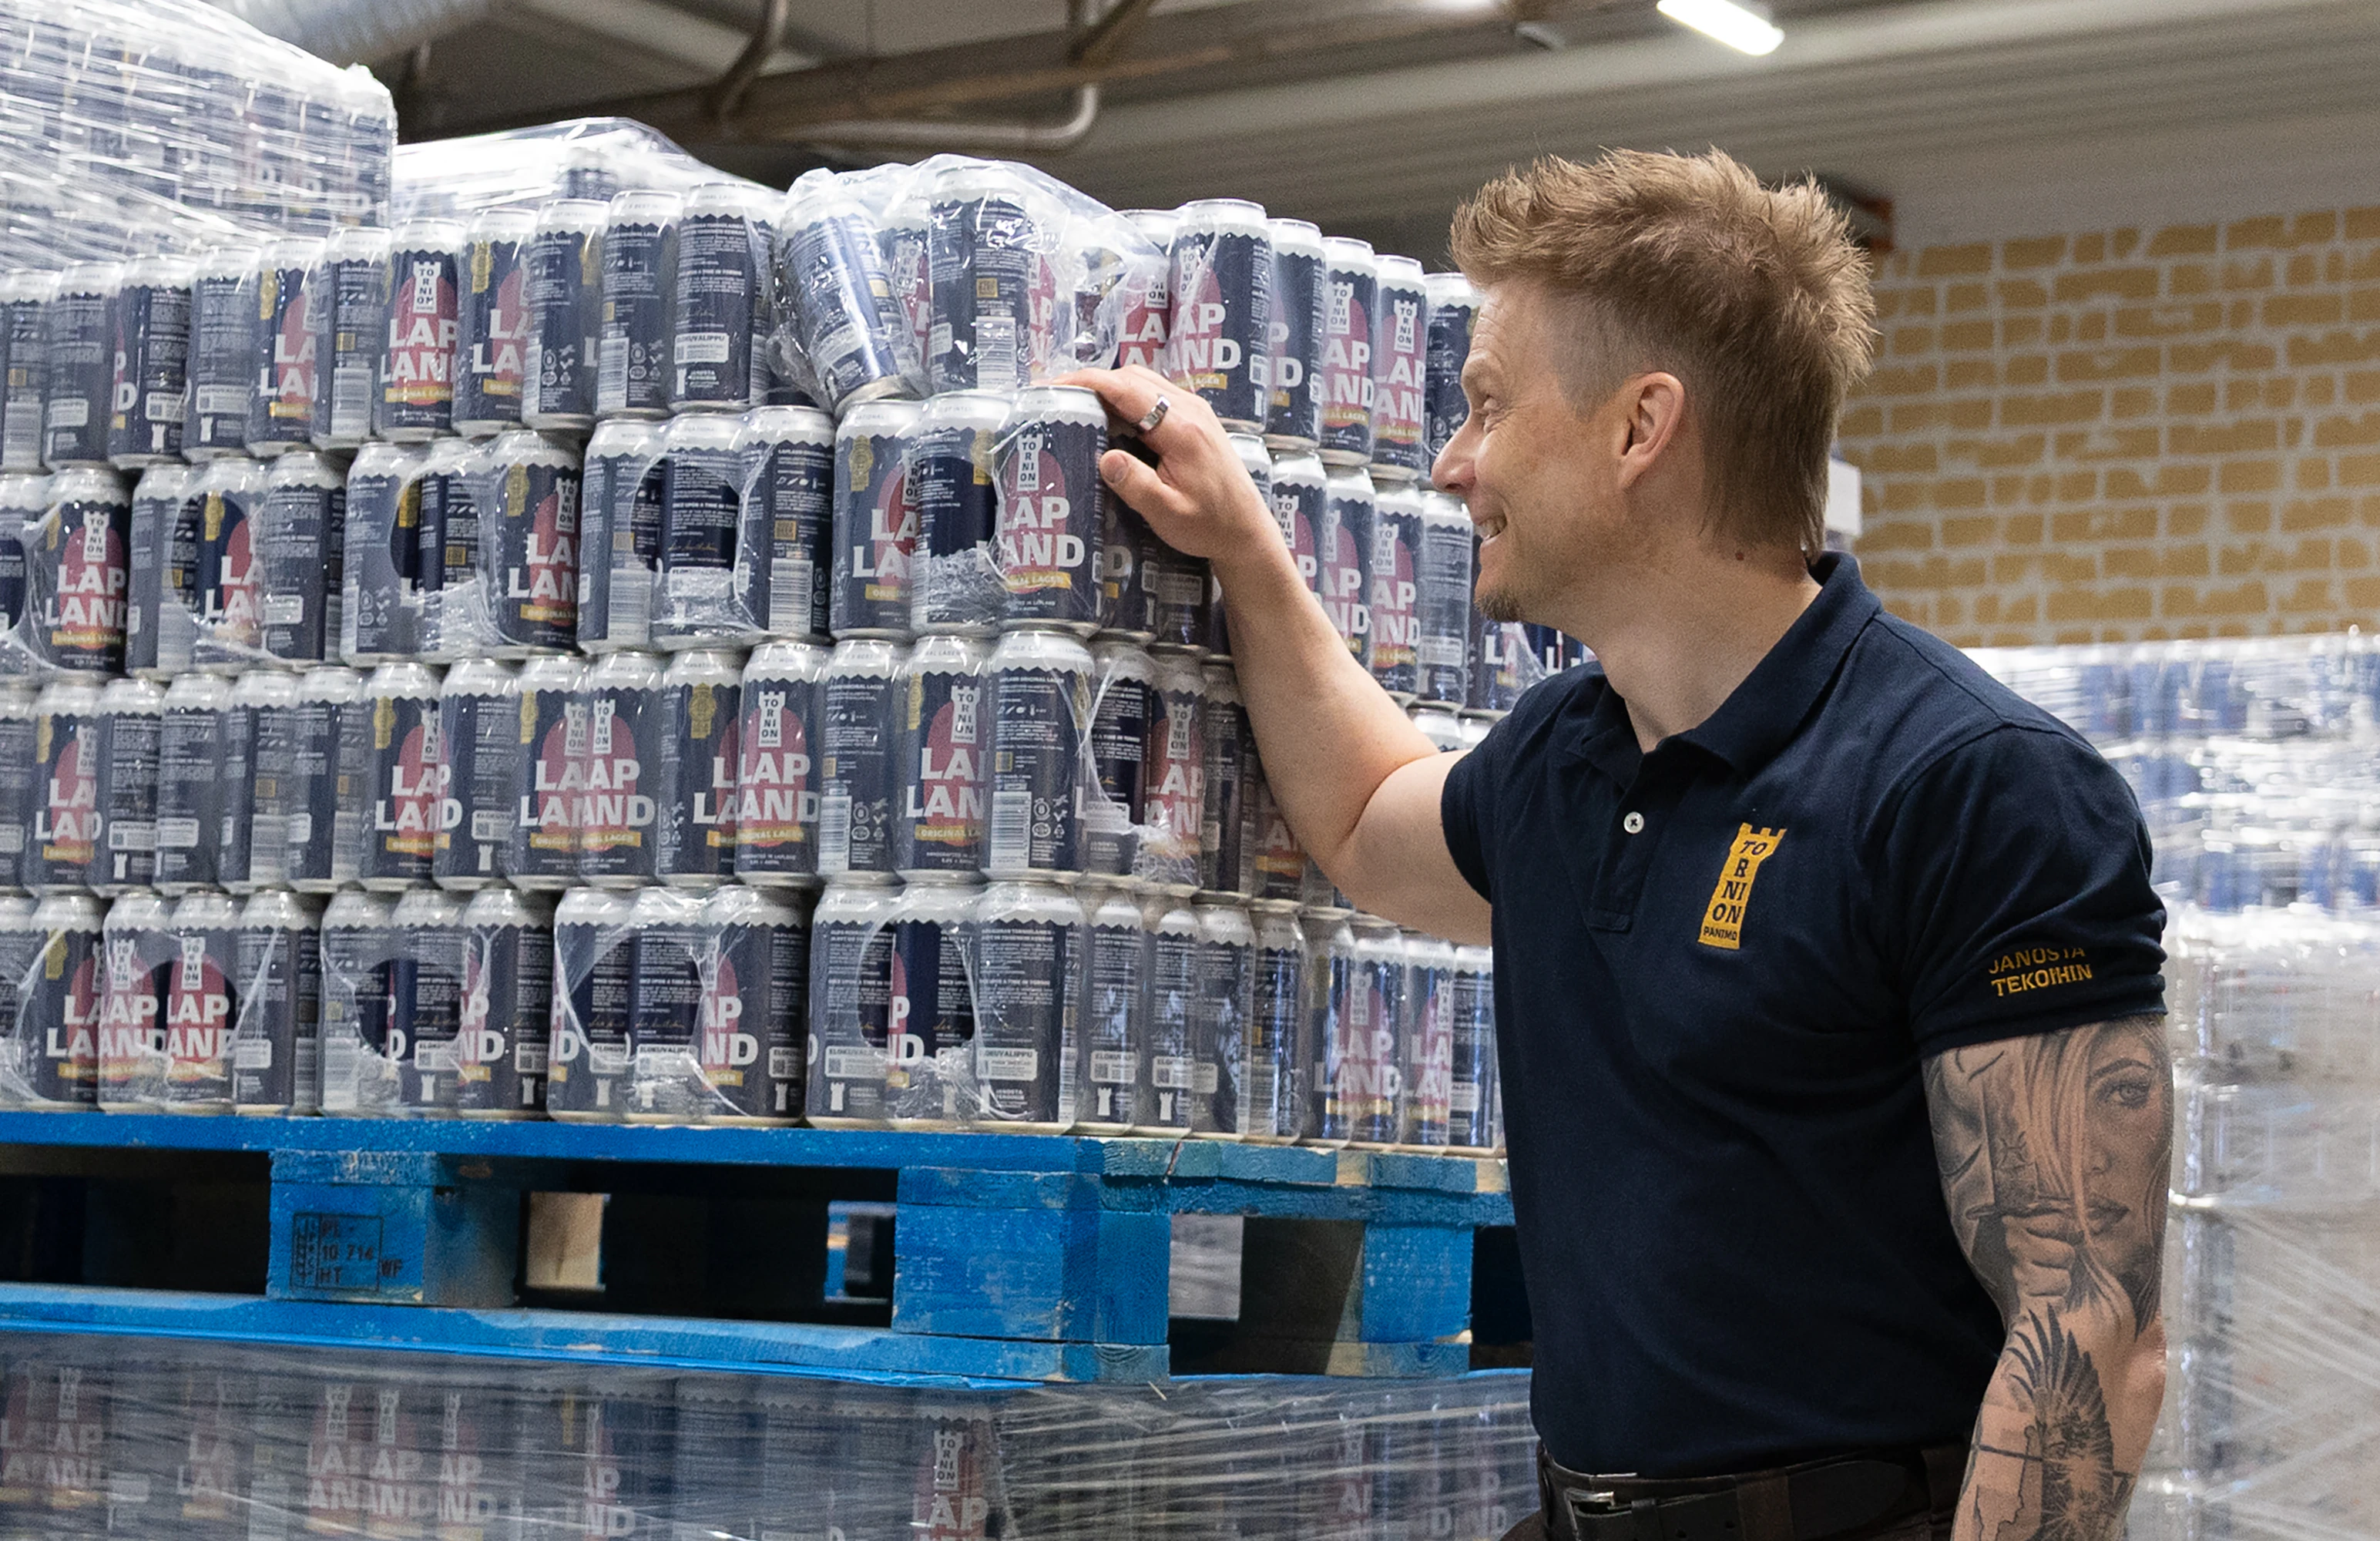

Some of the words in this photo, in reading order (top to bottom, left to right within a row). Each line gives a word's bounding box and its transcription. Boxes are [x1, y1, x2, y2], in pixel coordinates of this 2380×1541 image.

[1183, 253, 1196, 263] TO
[418, 268, 435, 277] TO
[418, 289, 433, 297] NI
[1150, 290, 1166, 300] ON
[1334, 287, 1348, 297] TO
[1336, 297, 1344, 307] R
[1333, 307, 1348, 317] NI
[1400, 307, 1413, 317] TO
[488, 308, 532, 340] LA
[1170, 303, 1226, 334] AP
[1331, 316, 1348, 326] ON
[1118, 312, 1167, 344] LA
[1399, 325, 1413, 335] NI
[1398, 334, 1413, 344] ON
[274, 333, 315, 364] LA
[472, 343, 526, 374] LA
[1167, 337, 1241, 372] AND
[1323, 338, 1370, 371] AP
[379, 351, 458, 384] LAN
[1022, 441, 1037, 452] TO
[1025, 452, 1033, 461] R
[1021, 462, 1037, 472] NI
[1019, 472, 1037, 482] ON
[561, 484, 575, 493] TO
[564, 495, 571, 503] R
[561, 504, 575, 513] NI
[1277, 502, 1293, 511] TO
[1281, 512, 1288, 520] R
[89, 518, 105, 527] TO
[871, 508, 917, 541] LA
[1378, 529, 1393, 539] TO
[86, 544, 105, 553] ON
[526, 533, 572, 566] LA
[1003, 533, 1086, 568] AND
[852, 545, 908, 578] LA
[220, 555, 260, 586] LA
[58, 564, 126, 596] LAP
[508, 567, 576, 601] LAN
[1322, 567, 1361, 599] AP
[1373, 580, 1416, 611] AP
[204, 589, 254, 620] LA
[764, 699, 780, 708] TO
[958, 693, 974, 703] TO
[597, 707, 609, 717] TO
[767, 708, 774, 717] R
[962, 703, 970, 713] R
[763, 719, 777, 727] NI
[958, 713, 972, 723] NI
[596, 727, 608, 735] NI
[760, 729, 779, 739] ON
[955, 724, 973, 735] ON
[594, 737, 609, 746] ON
[921, 748, 972, 781] LA
[534, 760, 583, 791] LA
[584, 758, 641, 790] AP
[392, 765, 435, 797] LA
[1160, 764, 1202, 797] AP
[49, 777, 97, 807] LA
[737, 789, 821, 822] AND
[906, 785, 984, 819] LAN
[583, 795, 656, 827] AND
[1740, 840, 1767, 857] TO
[1734, 858, 1748, 878] R
[1720, 880, 1746, 901] NI
[1711, 903, 1741, 925] ON
[1703, 926, 1737, 942] PANIMO
[64, 995, 102, 1025] LA
[46, 1027, 99, 1058] LA
[703, 1032, 758, 1066] ND
[1412, 1034, 1450, 1065] LA
[939, 1439, 956, 1449] TO
[942, 1450, 951, 1459] R
[938, 1461, 955, 1470] NI
[937, 1471, 956, 1481] ON
